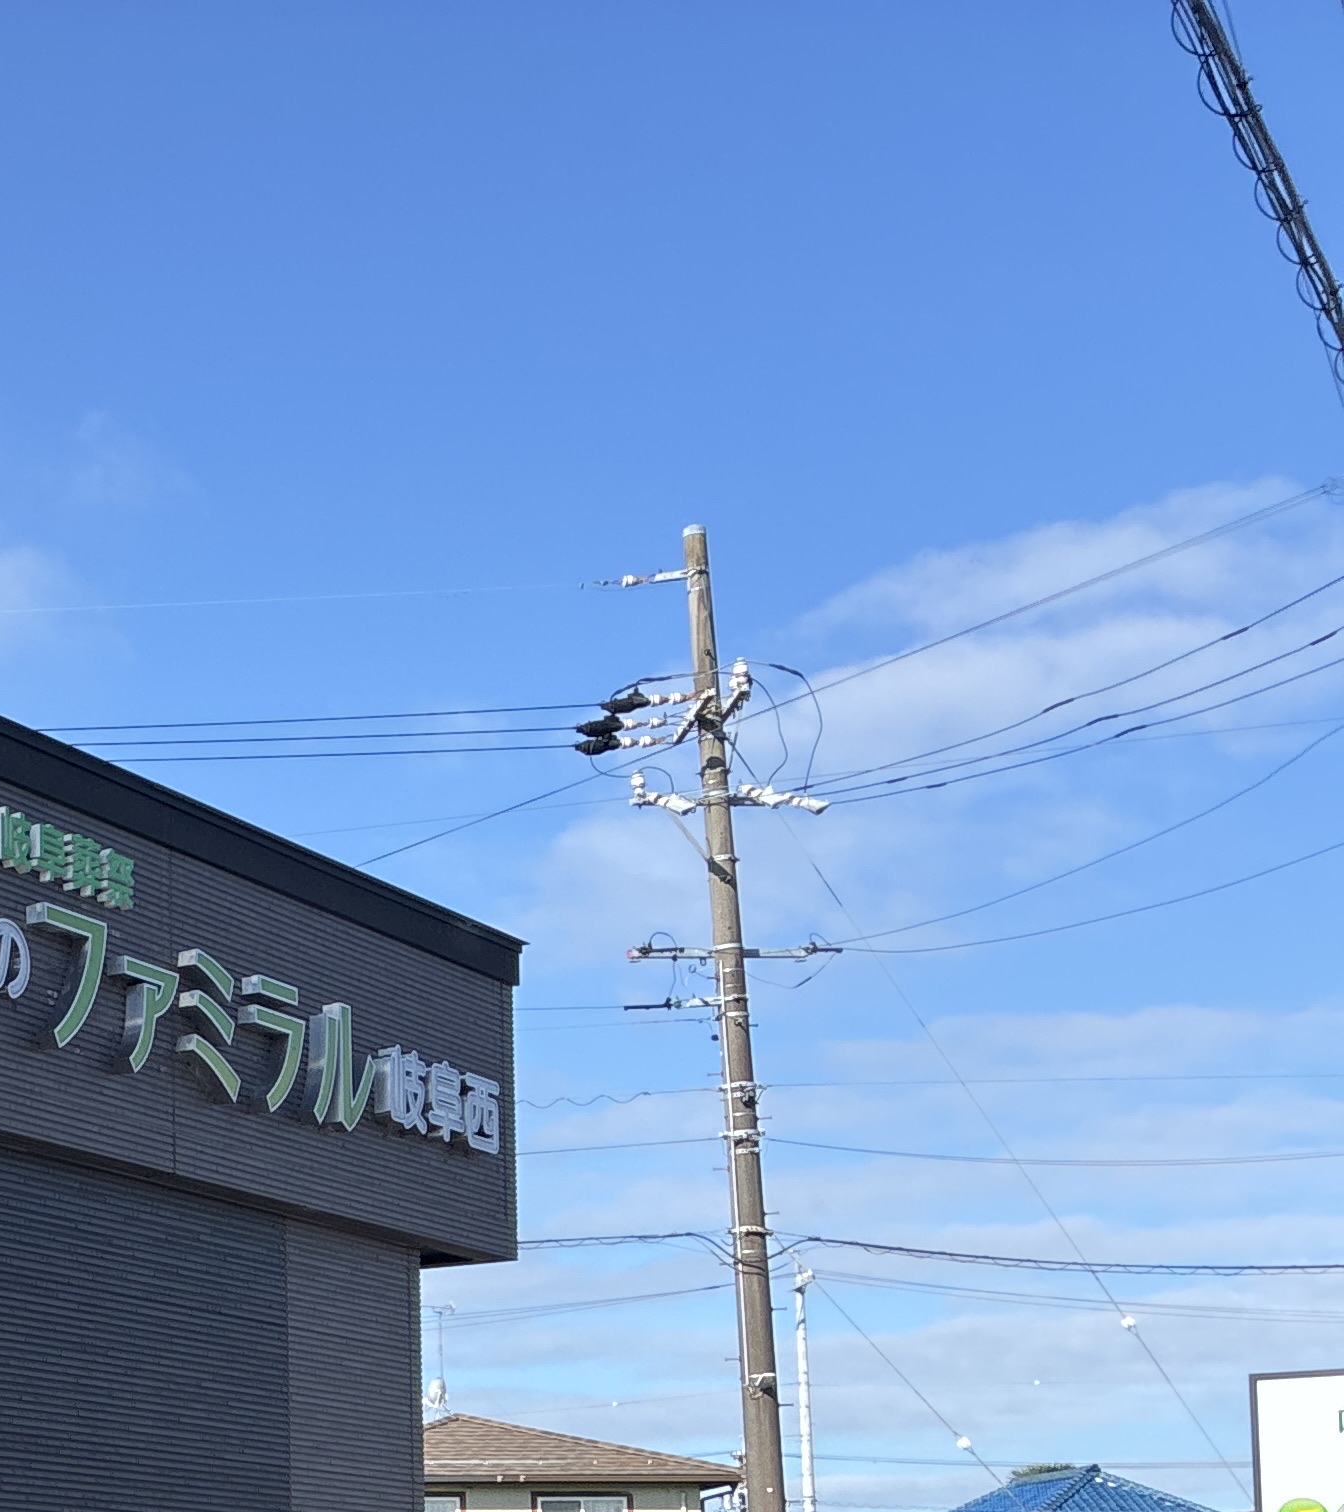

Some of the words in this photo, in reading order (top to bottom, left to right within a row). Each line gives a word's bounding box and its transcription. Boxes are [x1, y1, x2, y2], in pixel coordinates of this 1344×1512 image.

[25, 901, 376, 1133] ファミラル
[373, 1043, 502, 1156] 岐阜西
